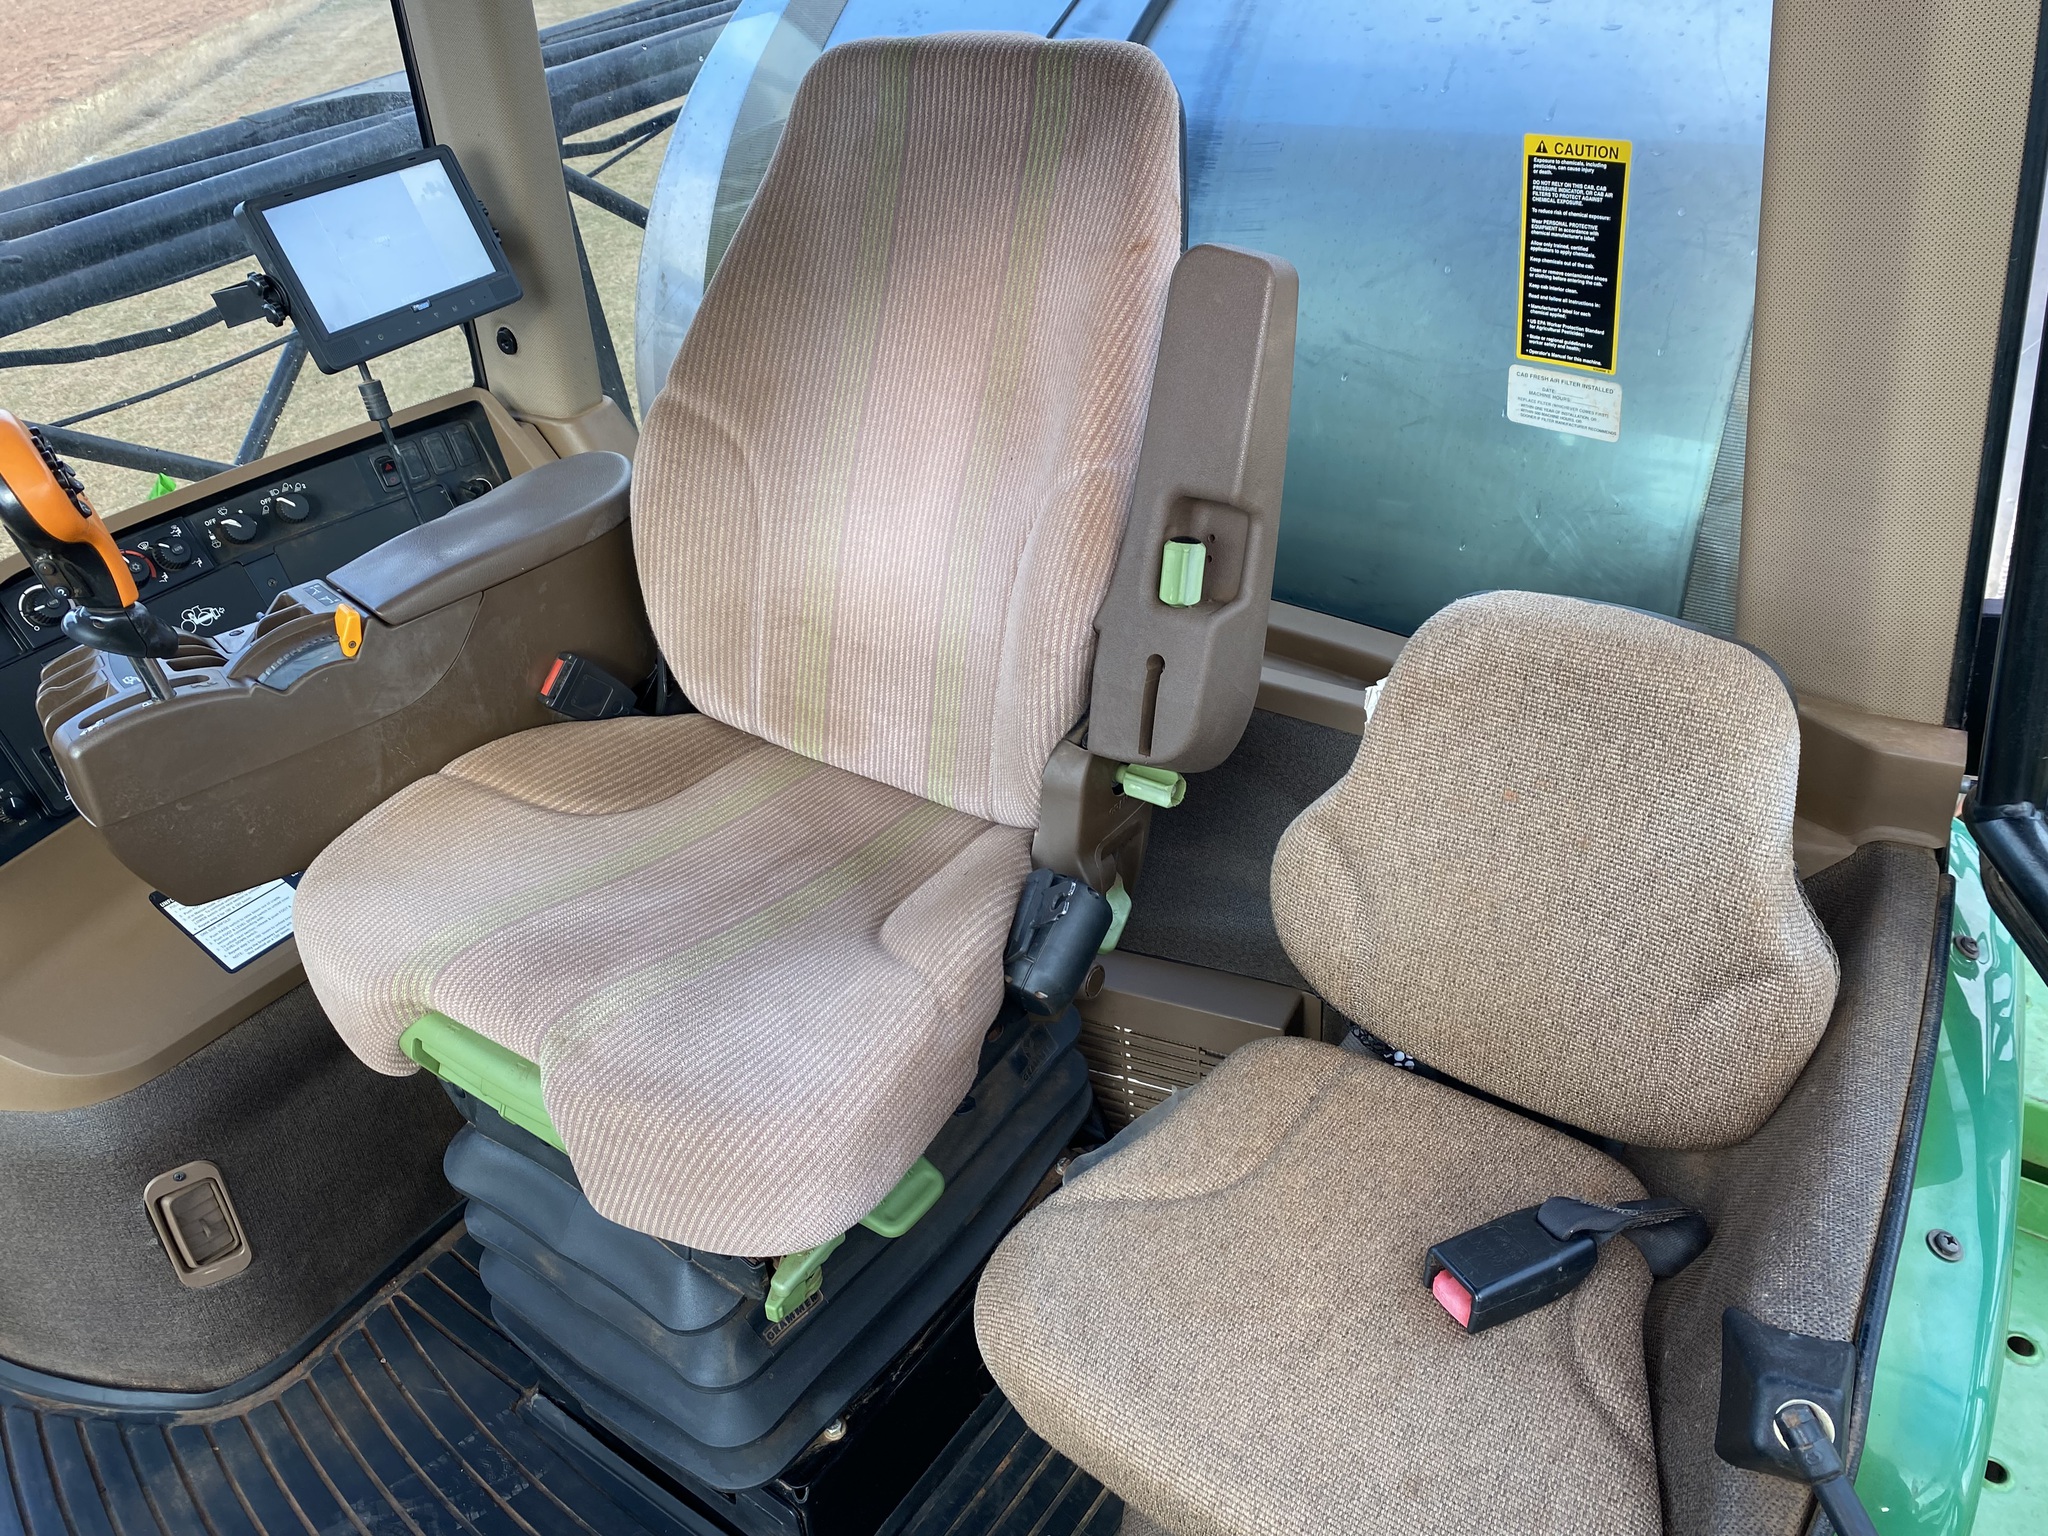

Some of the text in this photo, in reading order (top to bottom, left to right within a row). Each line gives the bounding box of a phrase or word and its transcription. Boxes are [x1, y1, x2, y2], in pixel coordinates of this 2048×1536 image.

[1554, 142, 1619, 160] CAUTION
[1531, 224, 1558, 232] EQUIPMENT
[1530, 374, 1549, 382] FRESH
[1561, 379, 1580, 388] FILTER
[1582, 383, 1614, 394] INSTALLED
[260, 497, 272, 506] OFF
[204, 518, 216, 527] OFF
[766, 1292, 818, 1340] GRAMMER
